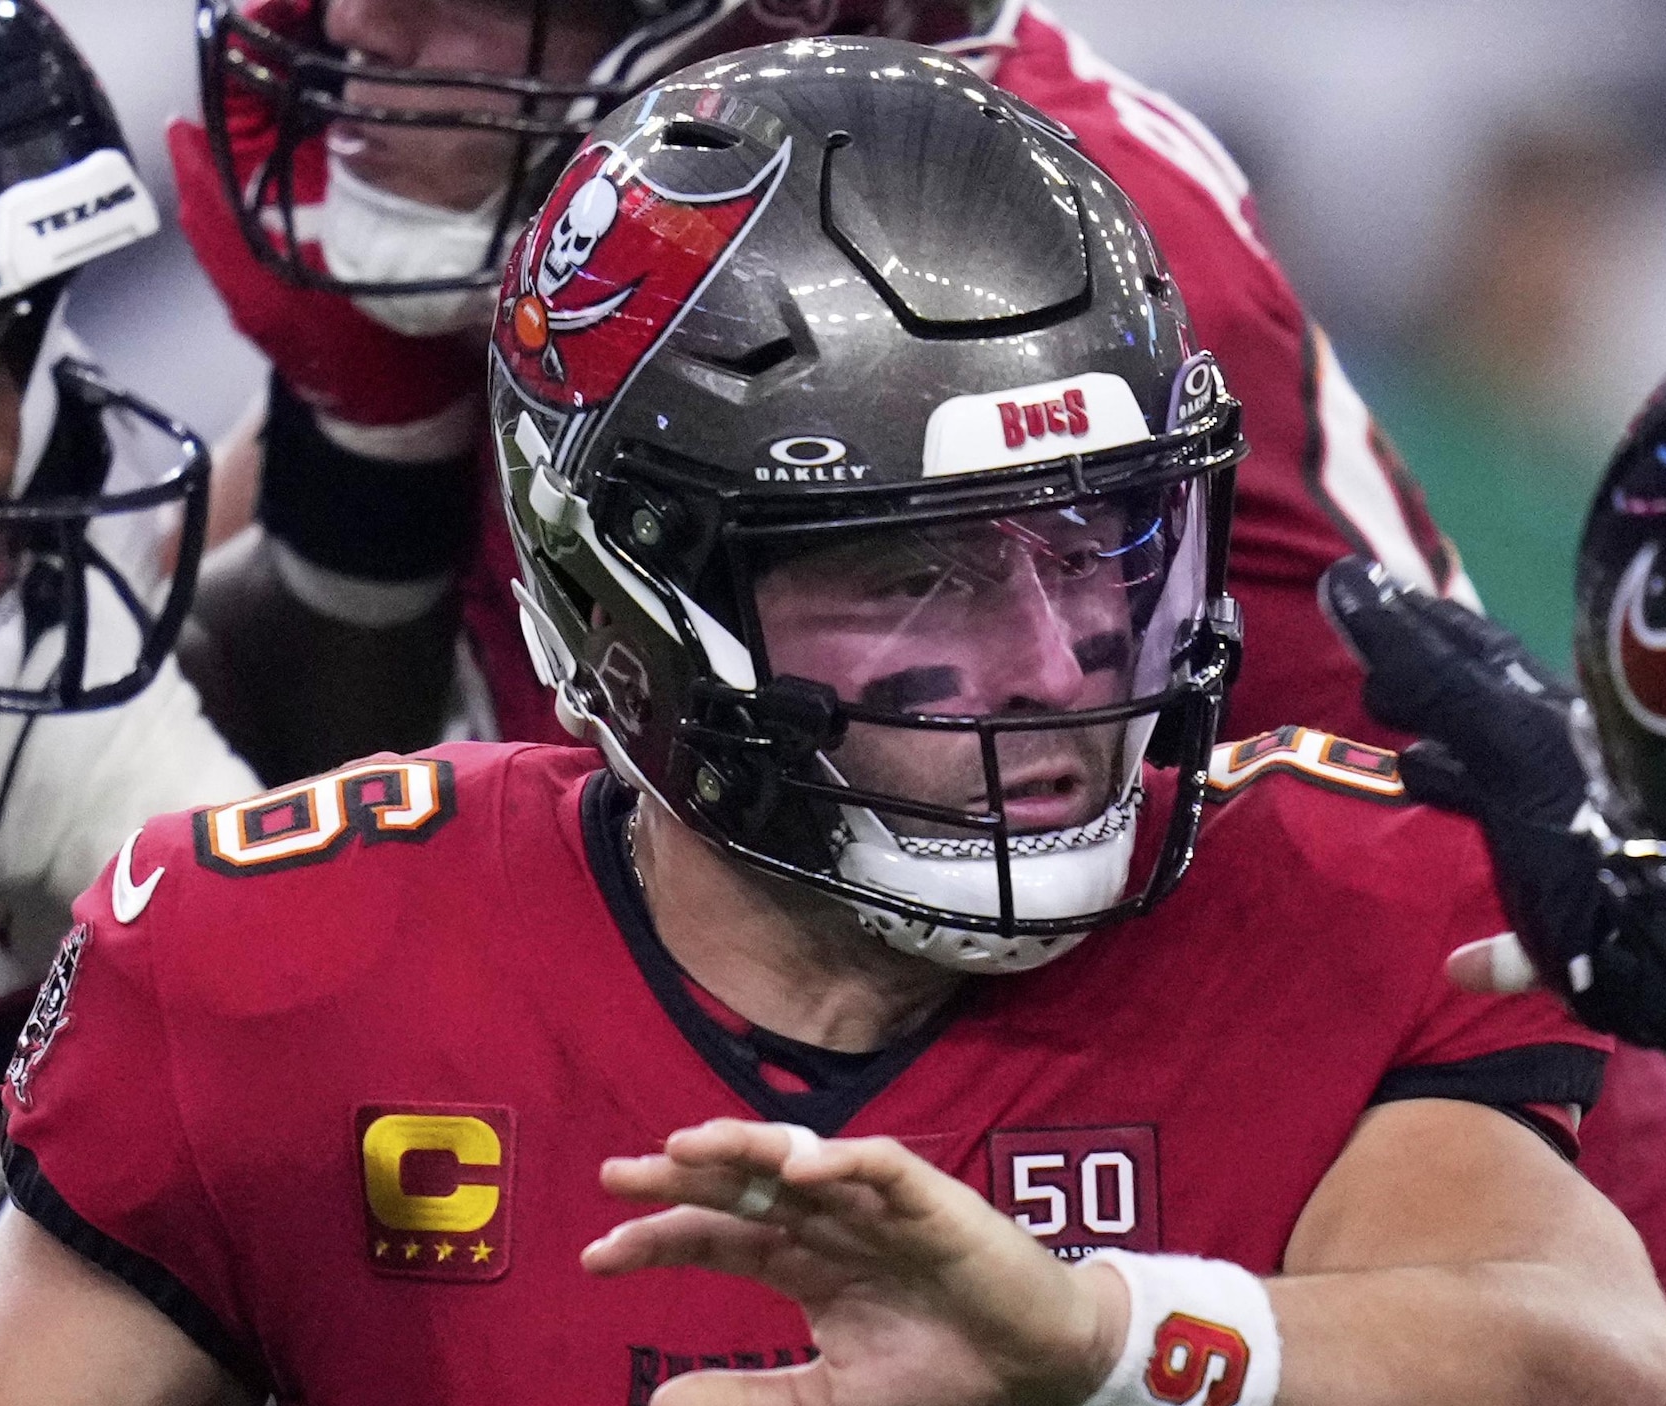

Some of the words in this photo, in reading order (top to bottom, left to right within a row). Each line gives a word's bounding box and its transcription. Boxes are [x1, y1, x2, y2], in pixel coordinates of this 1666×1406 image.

[997, 388, 1090, 450] BUCS
[754, 464, 866, 481] OAKLEY
[194, 759, 458, 878] 6
[363, 1114, 501, 1233] C
[1012, 1151, 1136, 1237] 50
